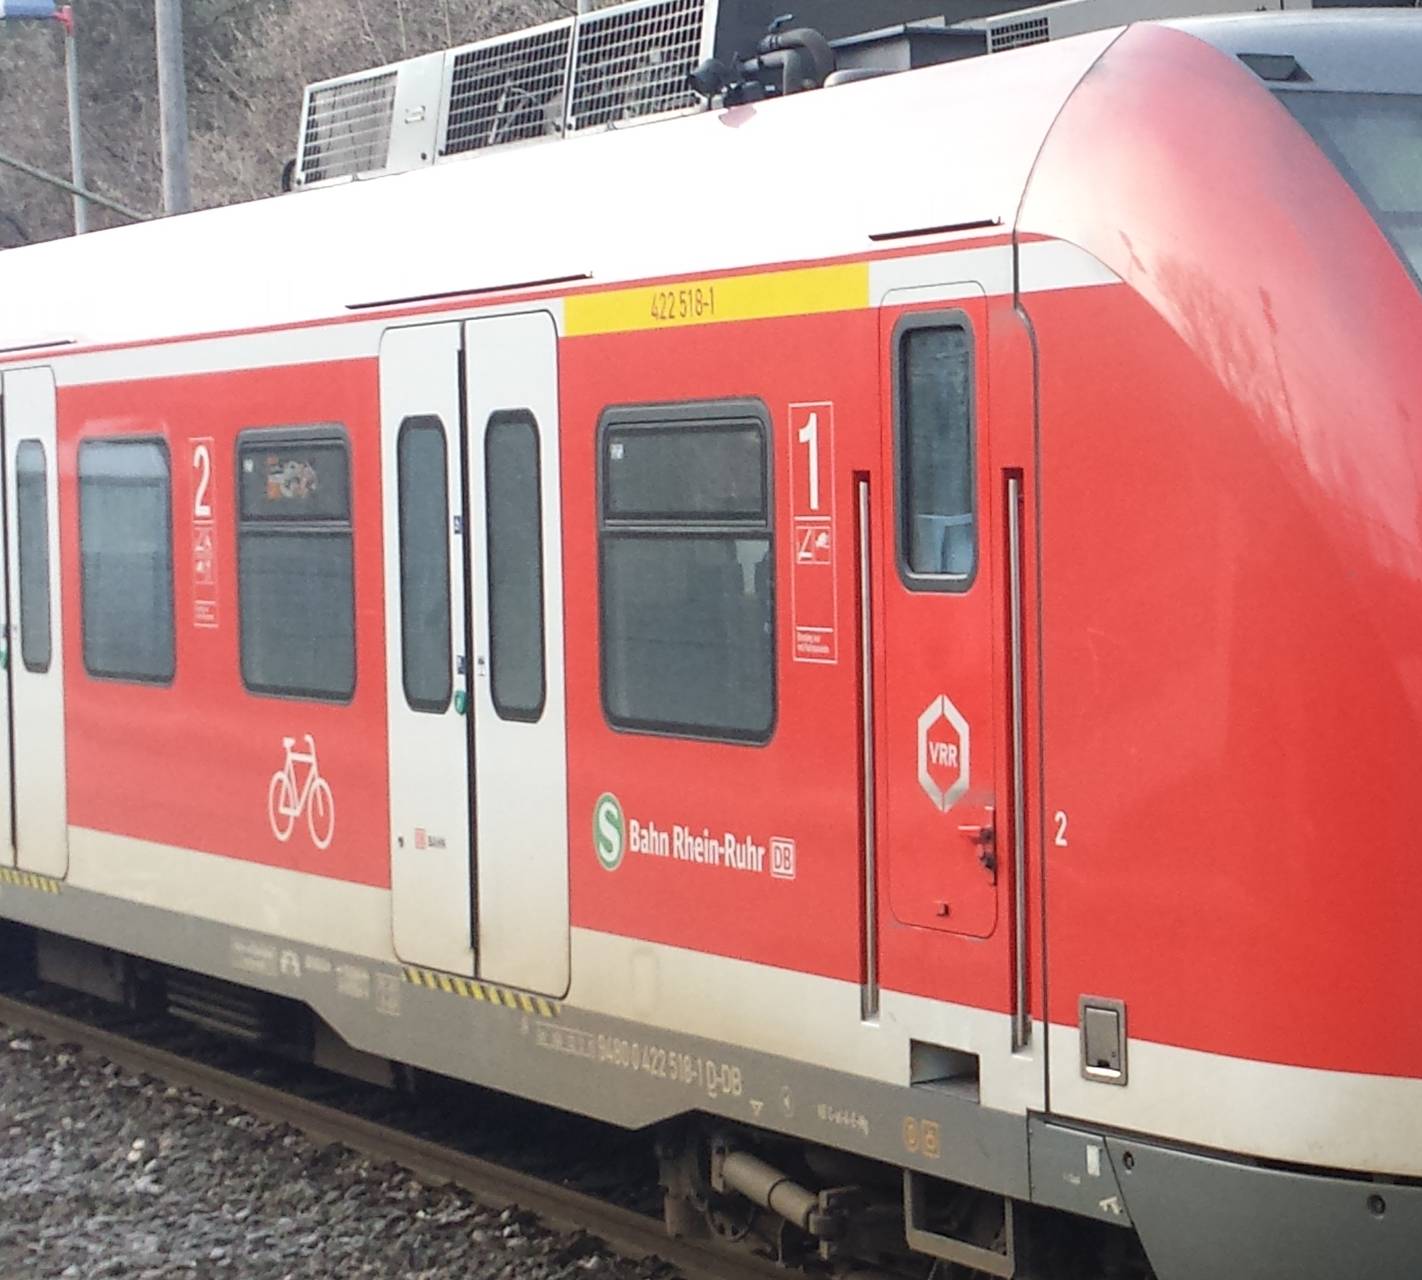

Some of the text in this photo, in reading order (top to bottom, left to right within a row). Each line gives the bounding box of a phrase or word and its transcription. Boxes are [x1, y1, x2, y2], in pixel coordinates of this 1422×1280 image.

[651, 286, 715, 320] 422 518-1
[193, 444, 211, 517] 2
[798, 412, 820, 510] 1
[928, 741, 958, 768] VRR
[598, 800, 622, 863] S
[629, 819, 669, 857] Bahn
[672, 825, 766, 873] Rhein-Ruhr
[1054, 810, 1068, 847] 2
[641, 1045, 667, 1078] 422
[668, 1051, 704, 1087] 518-1
[705, 1059, 743, 1098] D-DB
